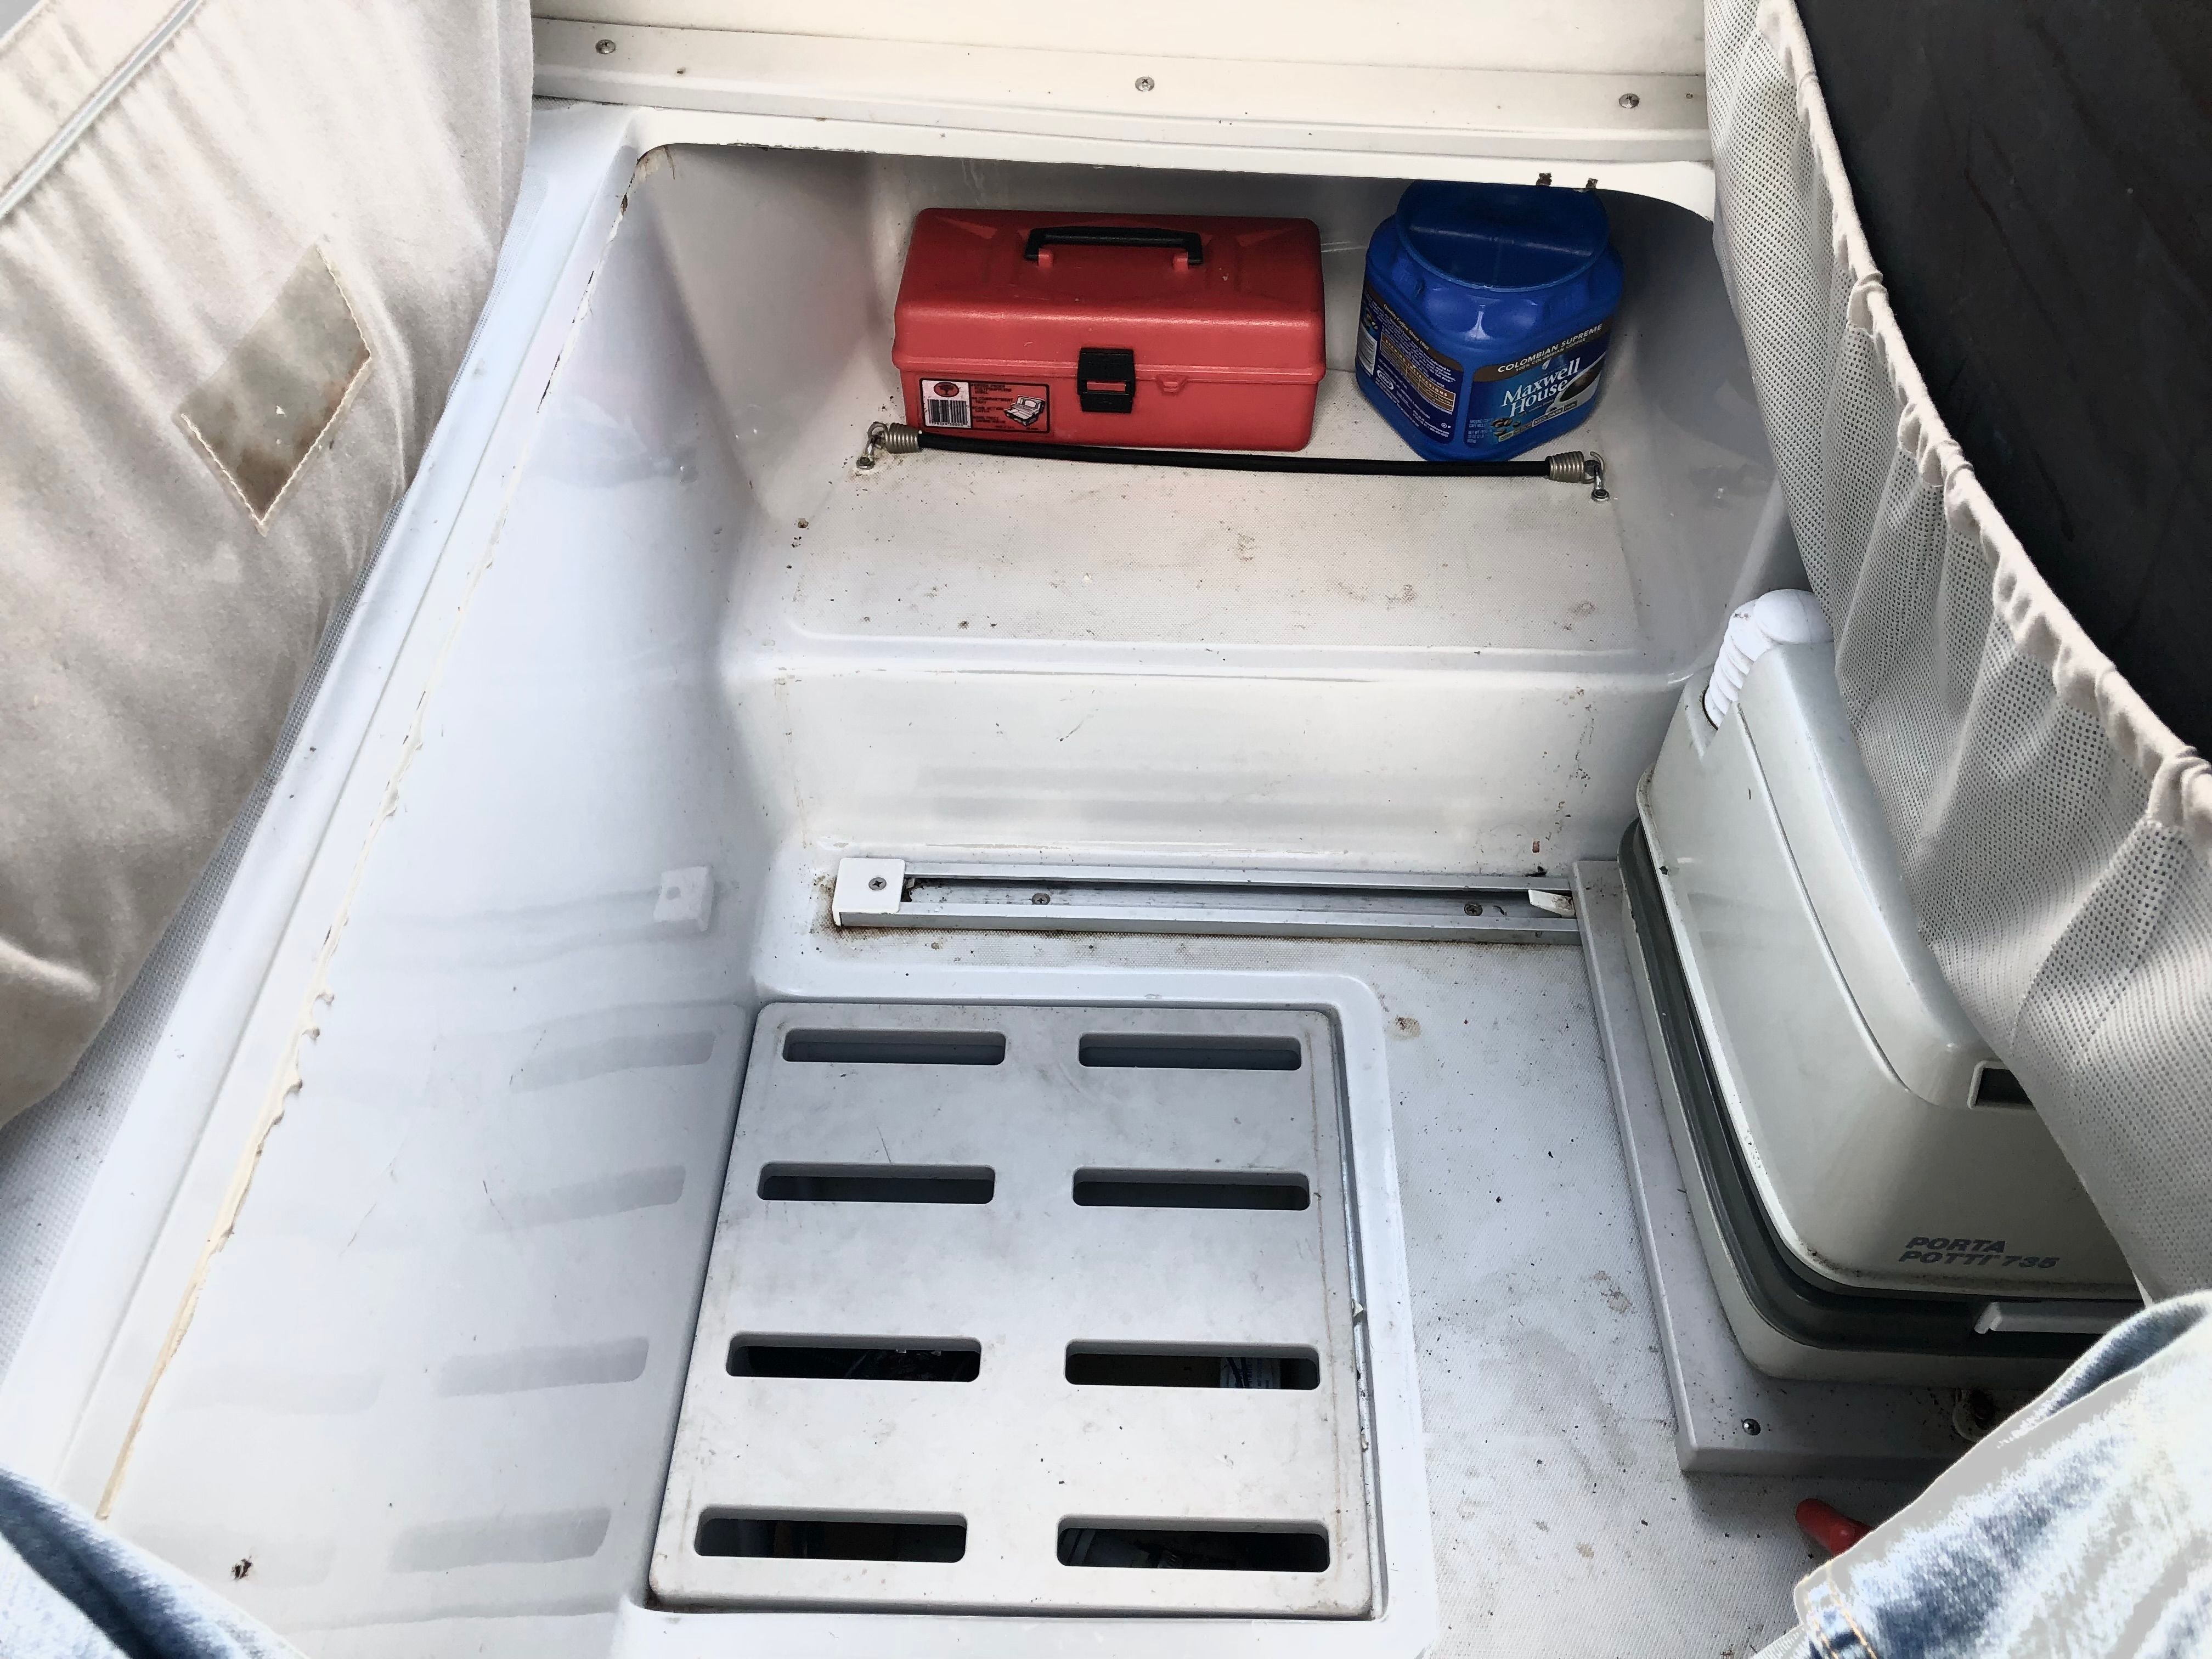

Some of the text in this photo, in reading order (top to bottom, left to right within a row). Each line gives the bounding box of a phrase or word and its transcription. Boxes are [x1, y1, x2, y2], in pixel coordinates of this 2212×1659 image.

[1498, 323, 1603, 373] COLOMBIAN SUPREME
[1515, 363, 1531, 373] 100%
[1531, 347, 1565, 365] COLOMBIAN
[1407, 363, 1447, 397] INSTRUCTIONS
[1501, 357, 1581, 407] Maxwell
[1509, 380, 1568, 417] House
[1898, 1250, 2061, 1269] POTTI 735
[1905, 1236, 2006, 1254] PORTA
